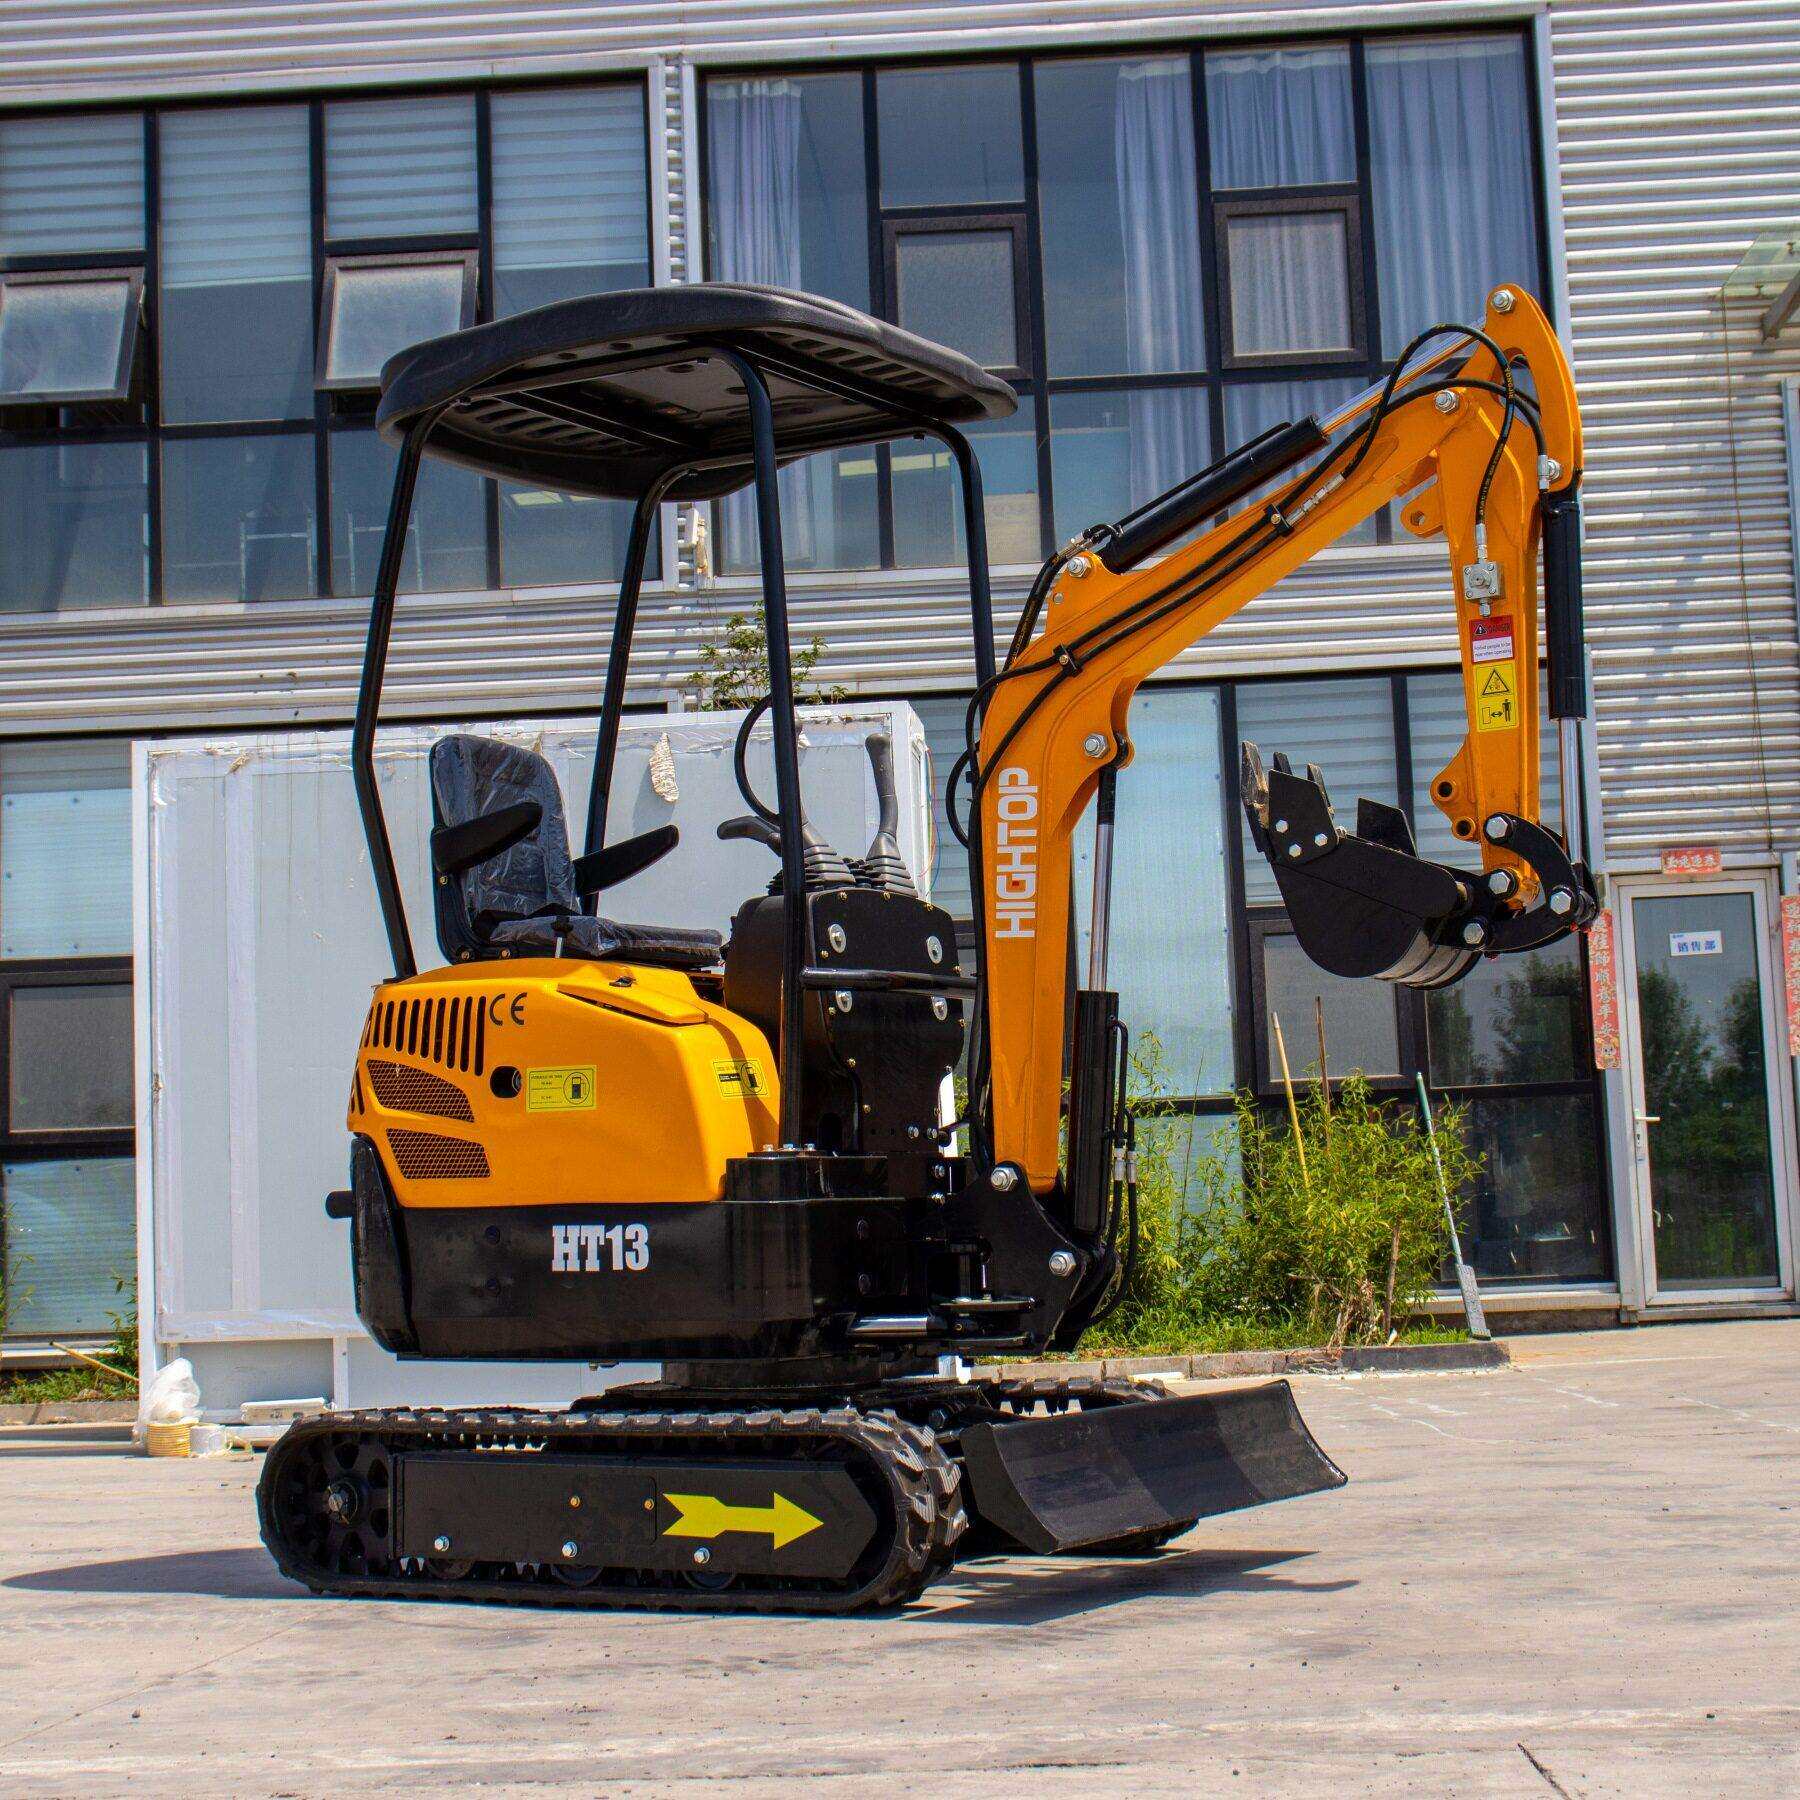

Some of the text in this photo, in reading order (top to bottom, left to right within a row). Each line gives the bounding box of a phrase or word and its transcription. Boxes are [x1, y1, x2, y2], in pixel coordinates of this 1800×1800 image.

[995, 767, 1038, 938] HIGHTOP
[489, 992, 528, 1026] CE
[551, 1223, 650, 1272] HT13
